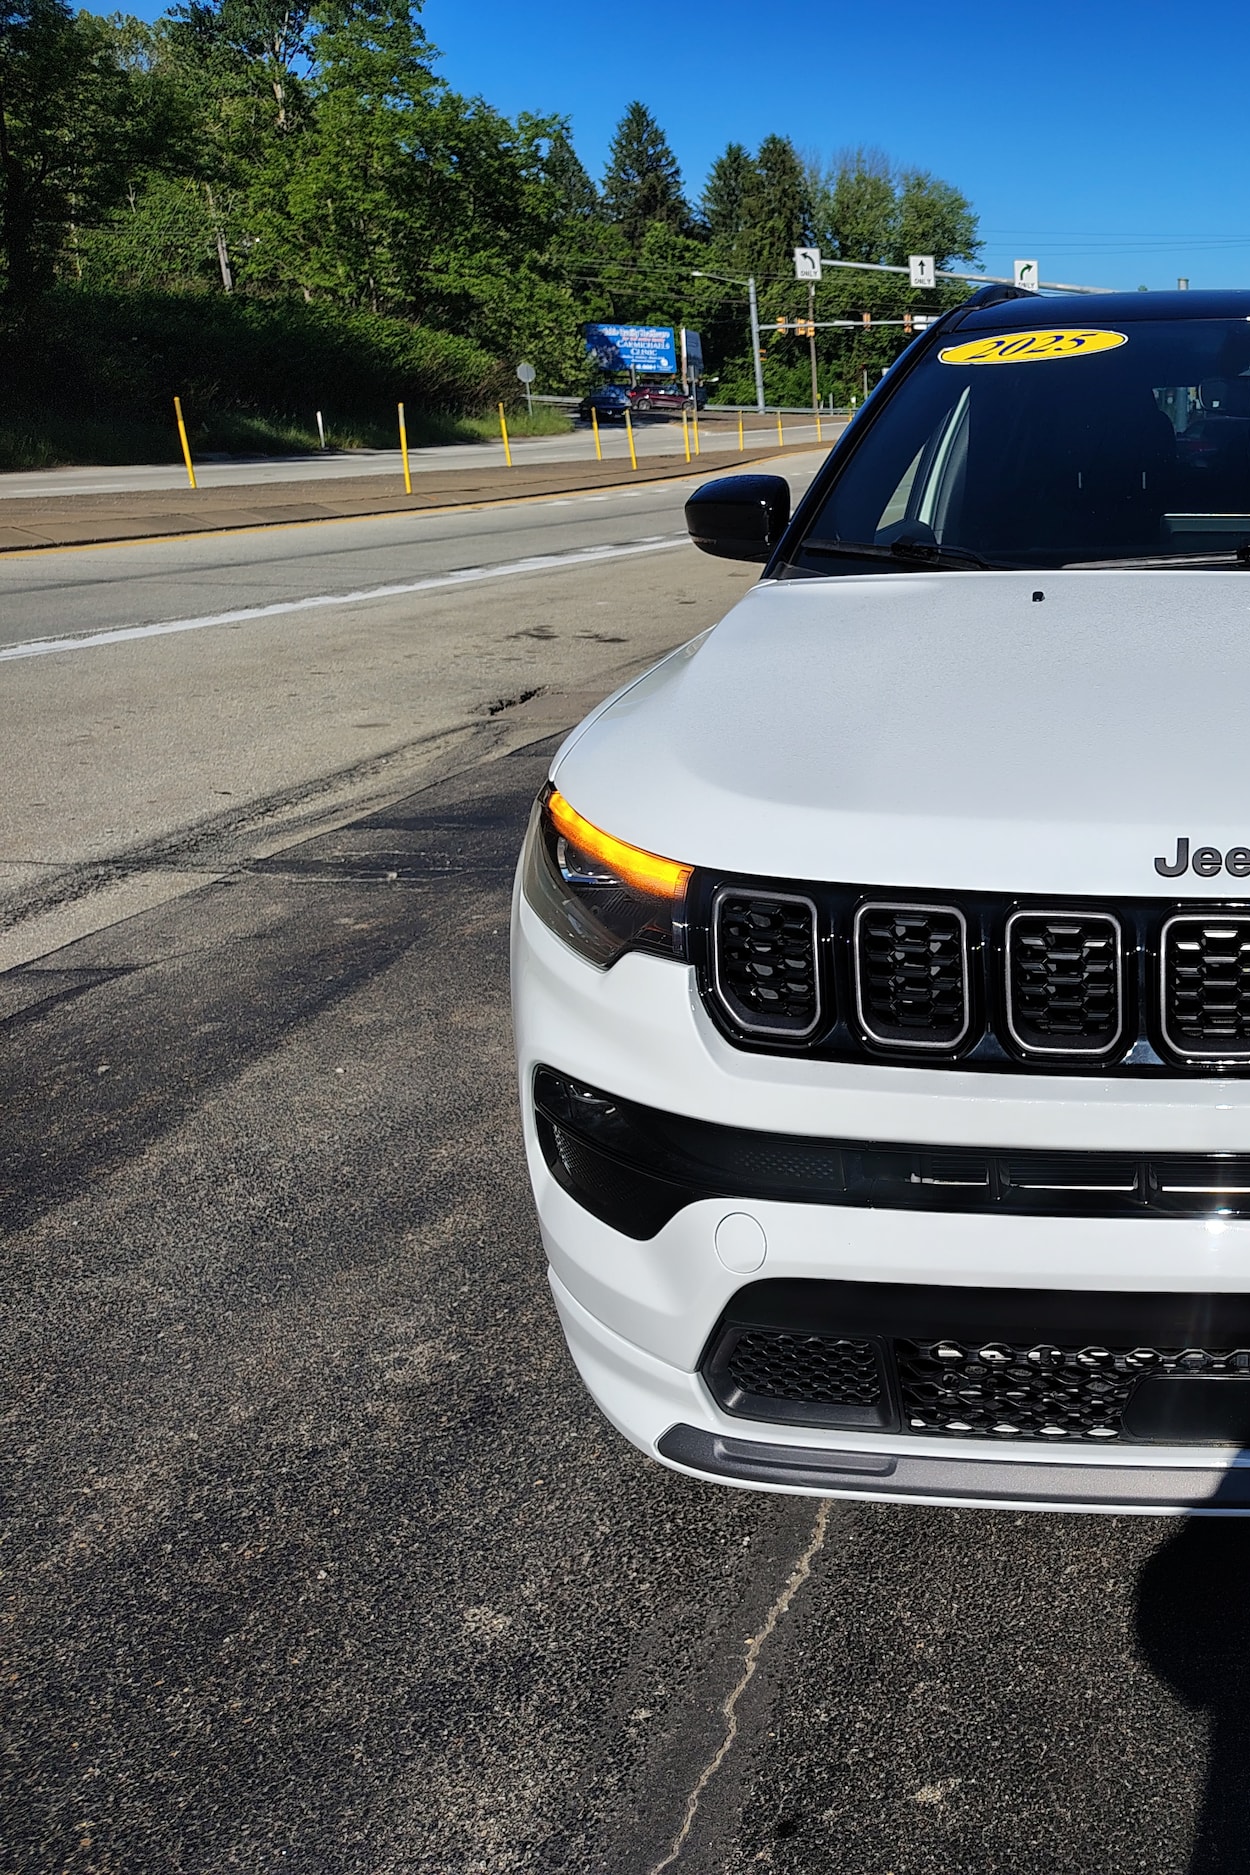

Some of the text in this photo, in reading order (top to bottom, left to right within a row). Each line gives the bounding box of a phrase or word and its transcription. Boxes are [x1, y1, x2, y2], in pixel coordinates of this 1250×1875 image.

[800, 270, 818, 278] ONLY
[914, 278, 932, 286] ONLY
[964, 333, 1099, 360] 2025
